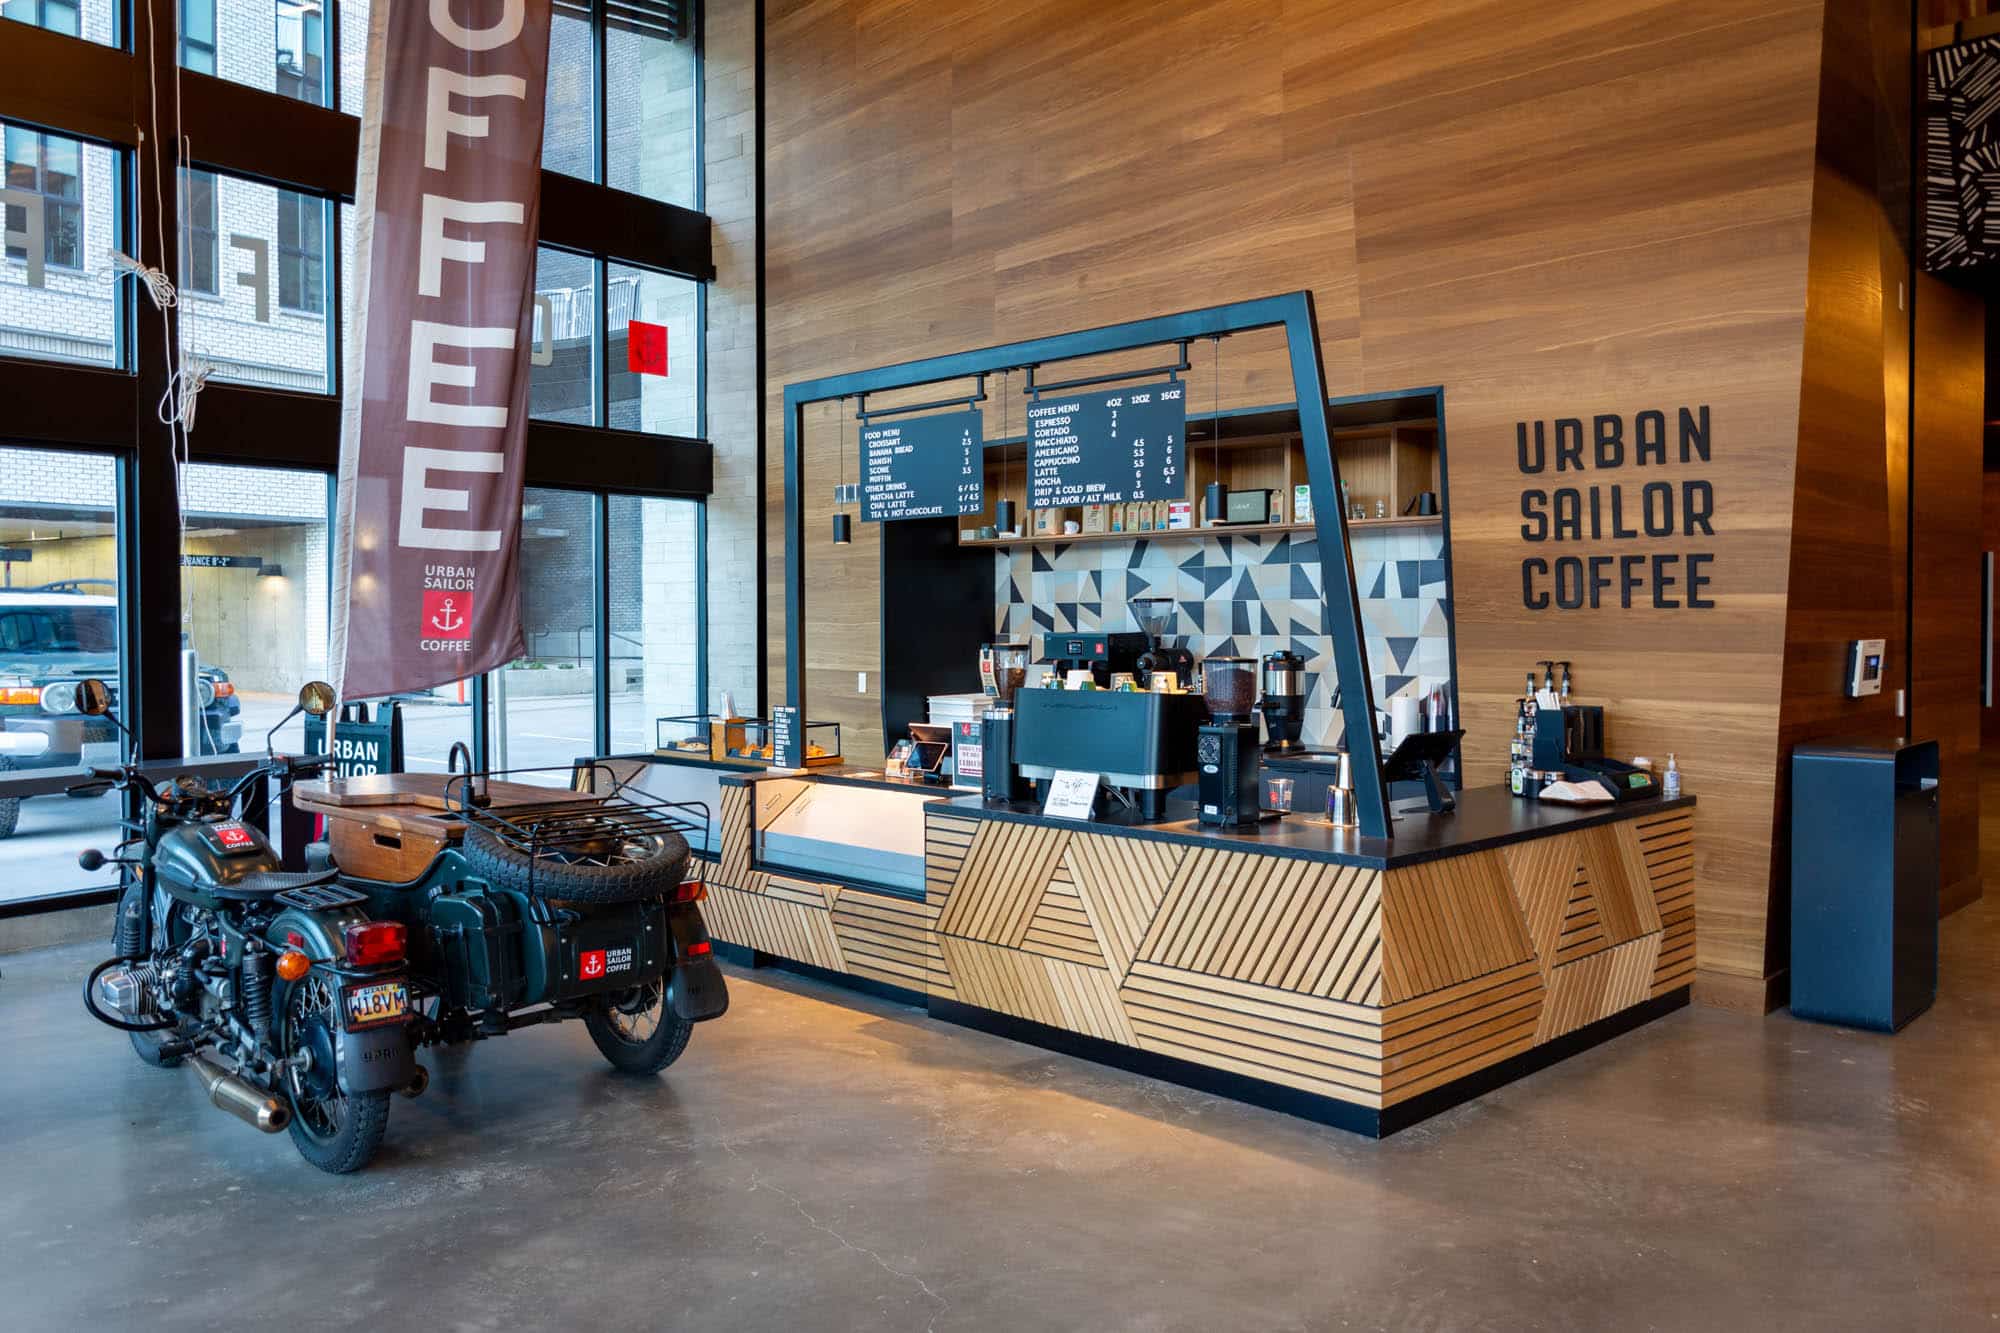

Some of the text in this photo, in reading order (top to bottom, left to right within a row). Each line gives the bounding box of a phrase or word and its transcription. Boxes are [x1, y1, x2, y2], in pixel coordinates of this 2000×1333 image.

[1028, 406, 1056, 418] COFFEE
[1058, 403, 1080, 413] MENU
[1035, 416, 1071, 428] ESPRESSO
[864, 432, 881, 440] FOOD
[1034, 426, 1070, 438] CORTADO
[1035, 436, 1078, 448] MACCHIATO
[1516, 404, 1711, 475] URBAN
[1035, 446, 1079, 458] AMERICANO
[1034, 456, 1080, 468] CAPPUCCINO
[1035, 468, 1058, 477] LATTE
[1034, 477, 1061, 487] MOCHA
[896, 491, 915, 499] LATTE
[1035, 488, 1053, 497] DRIP
[1062, 485, 1084, 494] COLD
[1086, 484, 1106, 492] BREW
[888, 500, 907, 508] LATTE
[1034, 498, 1050, 506] ADD
[1052, 495, 1080, 505] FLAVOR
[1087, 494, 1100, 503] ALT
[1103, 492, 1121, 501] MILK
[892, 509, 904, 517] HOT
[905, 506, 943, 515] CHOCOLATE
[1520, 479, 1716, 542] SAILOR
[425, 564, 475, 578] URBAN
[424, 577, 474, 590] SAILOR
[1521, 552, 1716, 610] COFFEE
[420, 640, 472, 652] COFFEE
[318, 738, 378, 762] URBAN
[606, 948, 632, 958] URBAN
[607, 955, 632, 964] SAILOR
[606, 962, 631, 973] COFFEE
